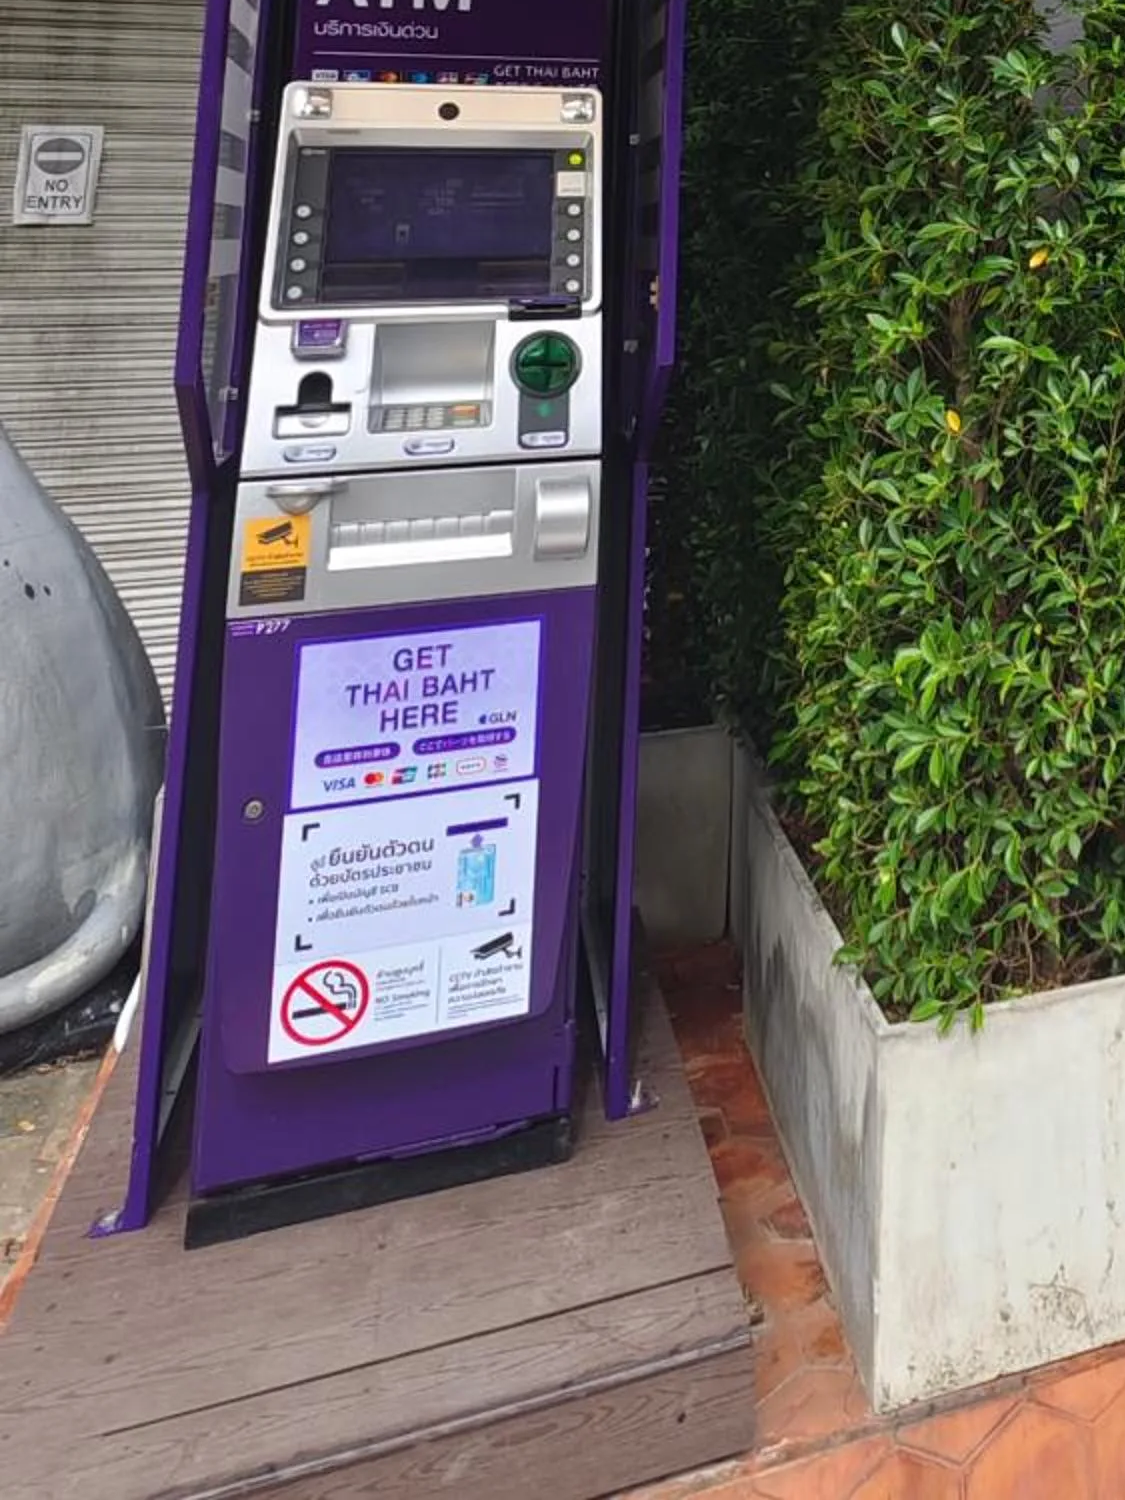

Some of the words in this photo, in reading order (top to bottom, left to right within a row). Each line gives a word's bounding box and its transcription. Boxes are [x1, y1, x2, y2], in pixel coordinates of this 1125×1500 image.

[313, 19, 439, 39] บริการเงินด่วน
[494, 65, 520, 77] GET
[526, 66, 558, 78] THAI
[561, 67, 599, 79] BAHT
[45, 180, 68, 192] NO
[27, 196, 83, 210] ENTRY
[393, 644, 453, 672] GET
[345, 680, 409, 708] THAI
[422, 669, 495, 698] BAHT
[380, 701, 458, 732] HERE
[489, 710, 517, 724] GLN
[323, 777, 356, 792] VISA
[328, 838, 434, 867] ยืนยันตัวตน
